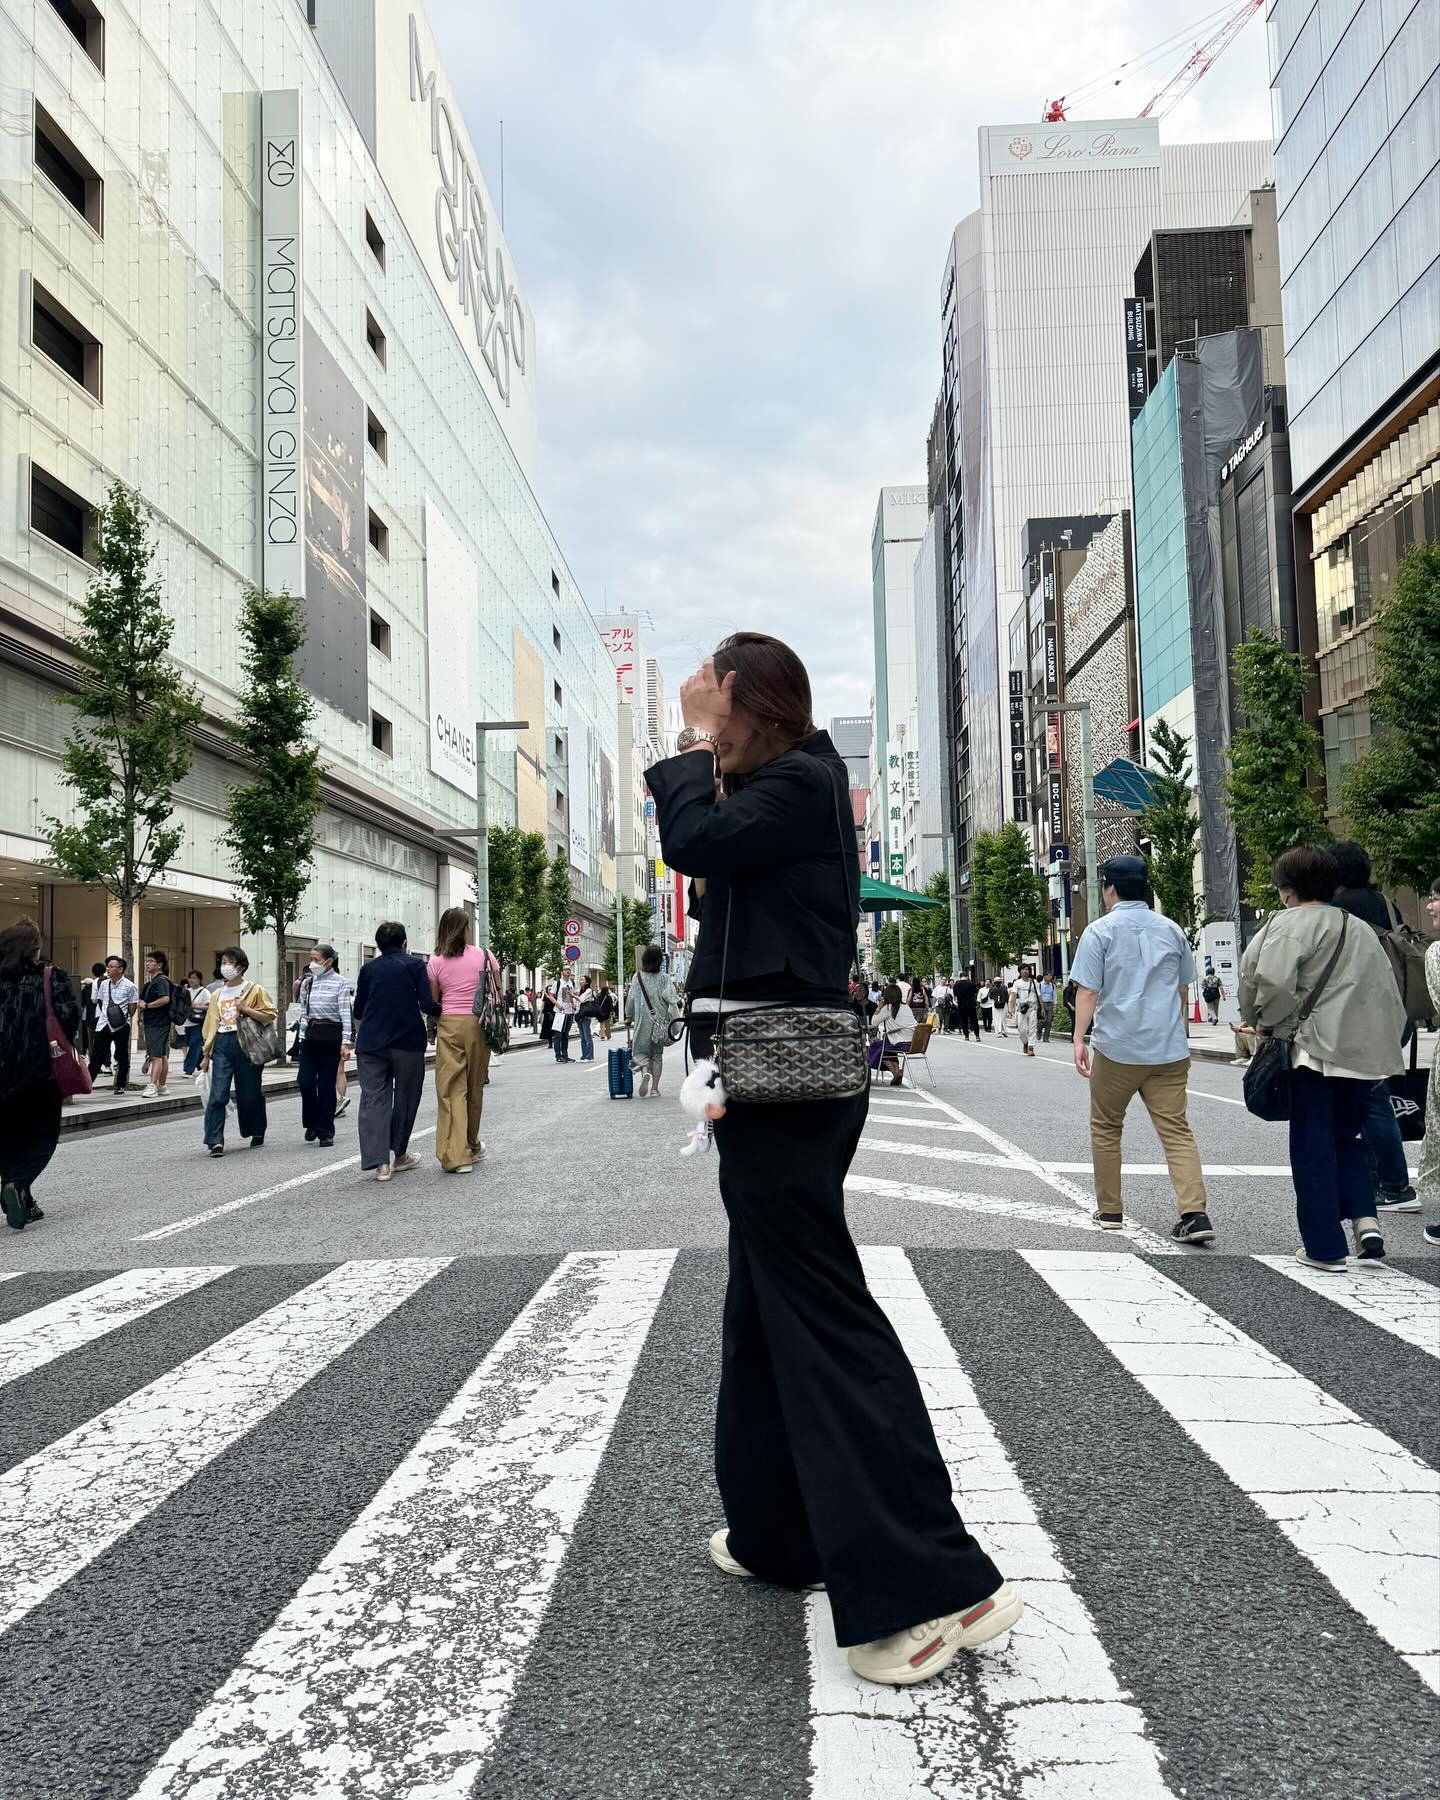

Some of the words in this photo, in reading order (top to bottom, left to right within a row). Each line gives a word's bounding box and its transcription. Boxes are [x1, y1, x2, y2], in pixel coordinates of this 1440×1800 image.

[1037, 134, 1087, 160] Loro
[1088, 129, 1143, 157] Piana
[1127, 310, 1135, 341] BUILDING
[1135, 302, 1143, 342] MATSUZAWA
[1136, 366, 1144, 394] ABBEY
[1048, 658, 1056, 683] UNIQUE
[436, 713, 476, 767] CHANEL
[888, 754, 901, 821] 教文館
[1052, 802, 1061, 834] PILATES
[891, 856, 903, 873] 本
